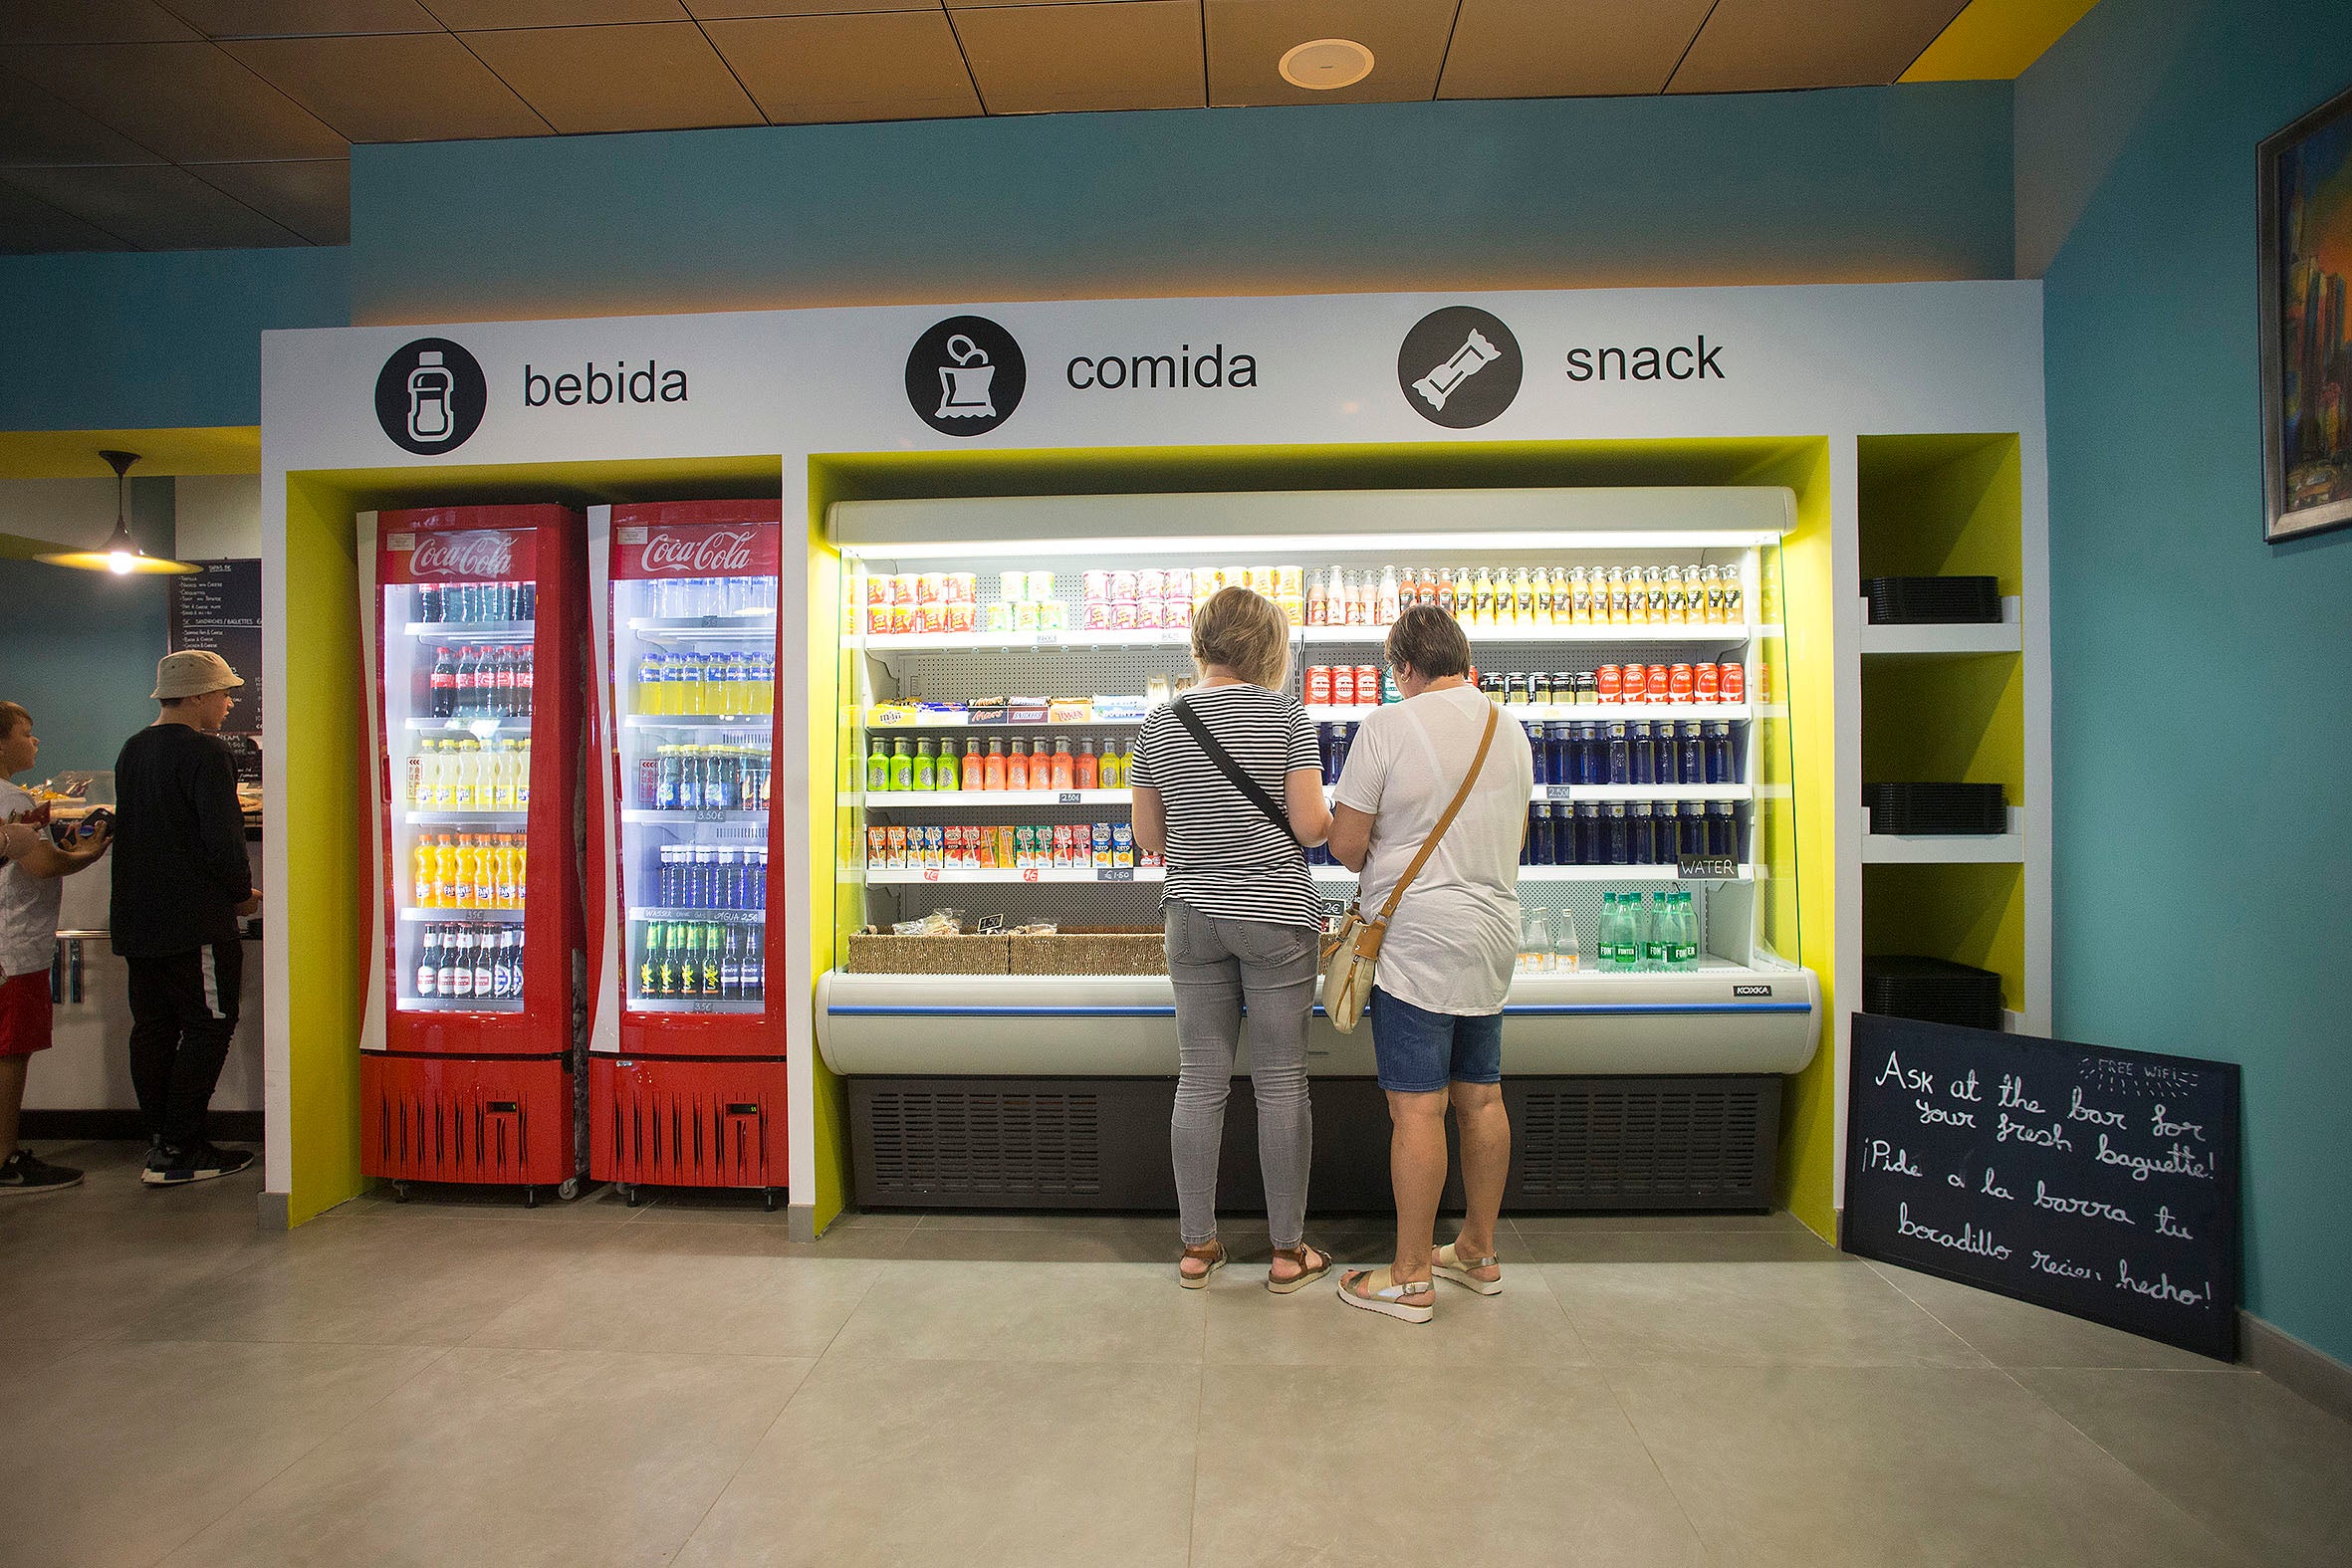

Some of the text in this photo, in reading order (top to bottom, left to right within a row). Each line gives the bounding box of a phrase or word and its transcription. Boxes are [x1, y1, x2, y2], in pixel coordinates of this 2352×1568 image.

[1065, 343, 1259, 390] comida
[1565, 335, 1726, 383] snack
[524, 360, 689, 408] bebida
[641, 531, 758, 572] Coca-Cola
[1681, 859, 1735, 874] WATER
[1737, 986, 1767, 995] KOXKA
[2098, 1058, 2133, 1076] FREE
[1875, 1050, 2206, 1142] Ask at the bar for
[1916, 1098, 2215, 1181] your fresh baguette!
[1948, 1171, 1965, 1189] a
[1981, 1167, 2013, 1201] la
[2033, 1180, 2135, 1226] barra
[2155, 1206, 2193, 1240] tu
[1898, 1202, 2211, 1309] bocadillo recien hecho!
